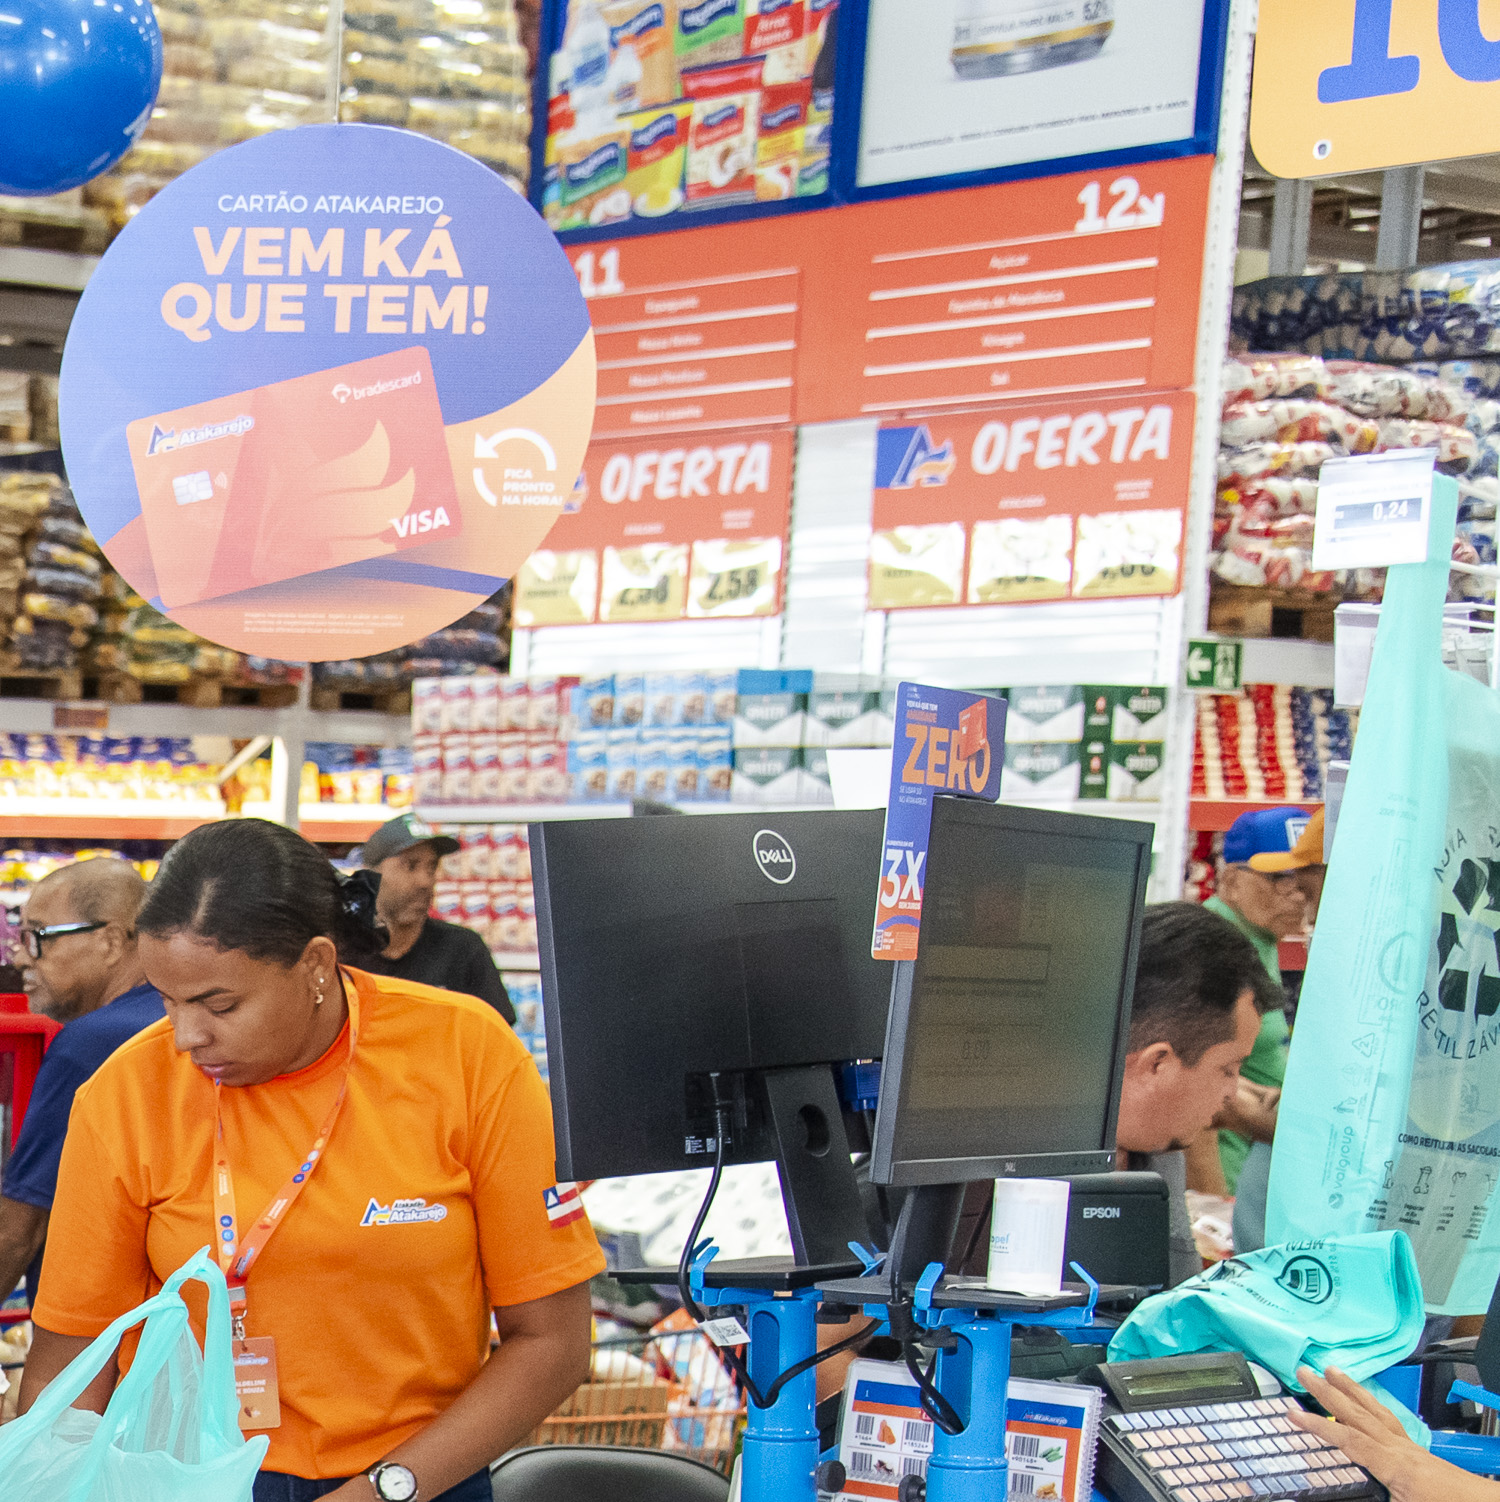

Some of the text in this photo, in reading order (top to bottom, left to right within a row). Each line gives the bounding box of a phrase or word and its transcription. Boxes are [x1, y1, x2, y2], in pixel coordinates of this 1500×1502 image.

[217, 189, 444, 215] CARTÃO ATAKAREJO
[1075, 177, 1140, 234] 12
[193, 215, 464, 278] VEM KÁ
[576, 249, 624, 297] 11
[160, 282, 489, 342] QUE TEM!
[352, 371, 422, 401] bradescard
[177, 415, 255, 450] Atakarejo
[971, 405, 1173, 476] OFERTA
[504, 469, 533, 480] FICA
[504, 481, 556, 493] PRONTO
[601, 442, 772, 504] OFERTA
[501, 494, 564, 506] NA HORA!
[1372, 501, 1409, 521] 0,24
[390, 506, 450, 538] VISA
[902, 723, 990, 793] ZERO
[760, 848, 791, 866] DELL
[881, 848, 926, 909] 3X
[1333, 1125, 1354, 1190] valgroup
[389, 1204, 447, 1224] Atakarejo
[1083, 1207, 1120, 1220] EPSON
[864, 1389, 870, 1398] 1
